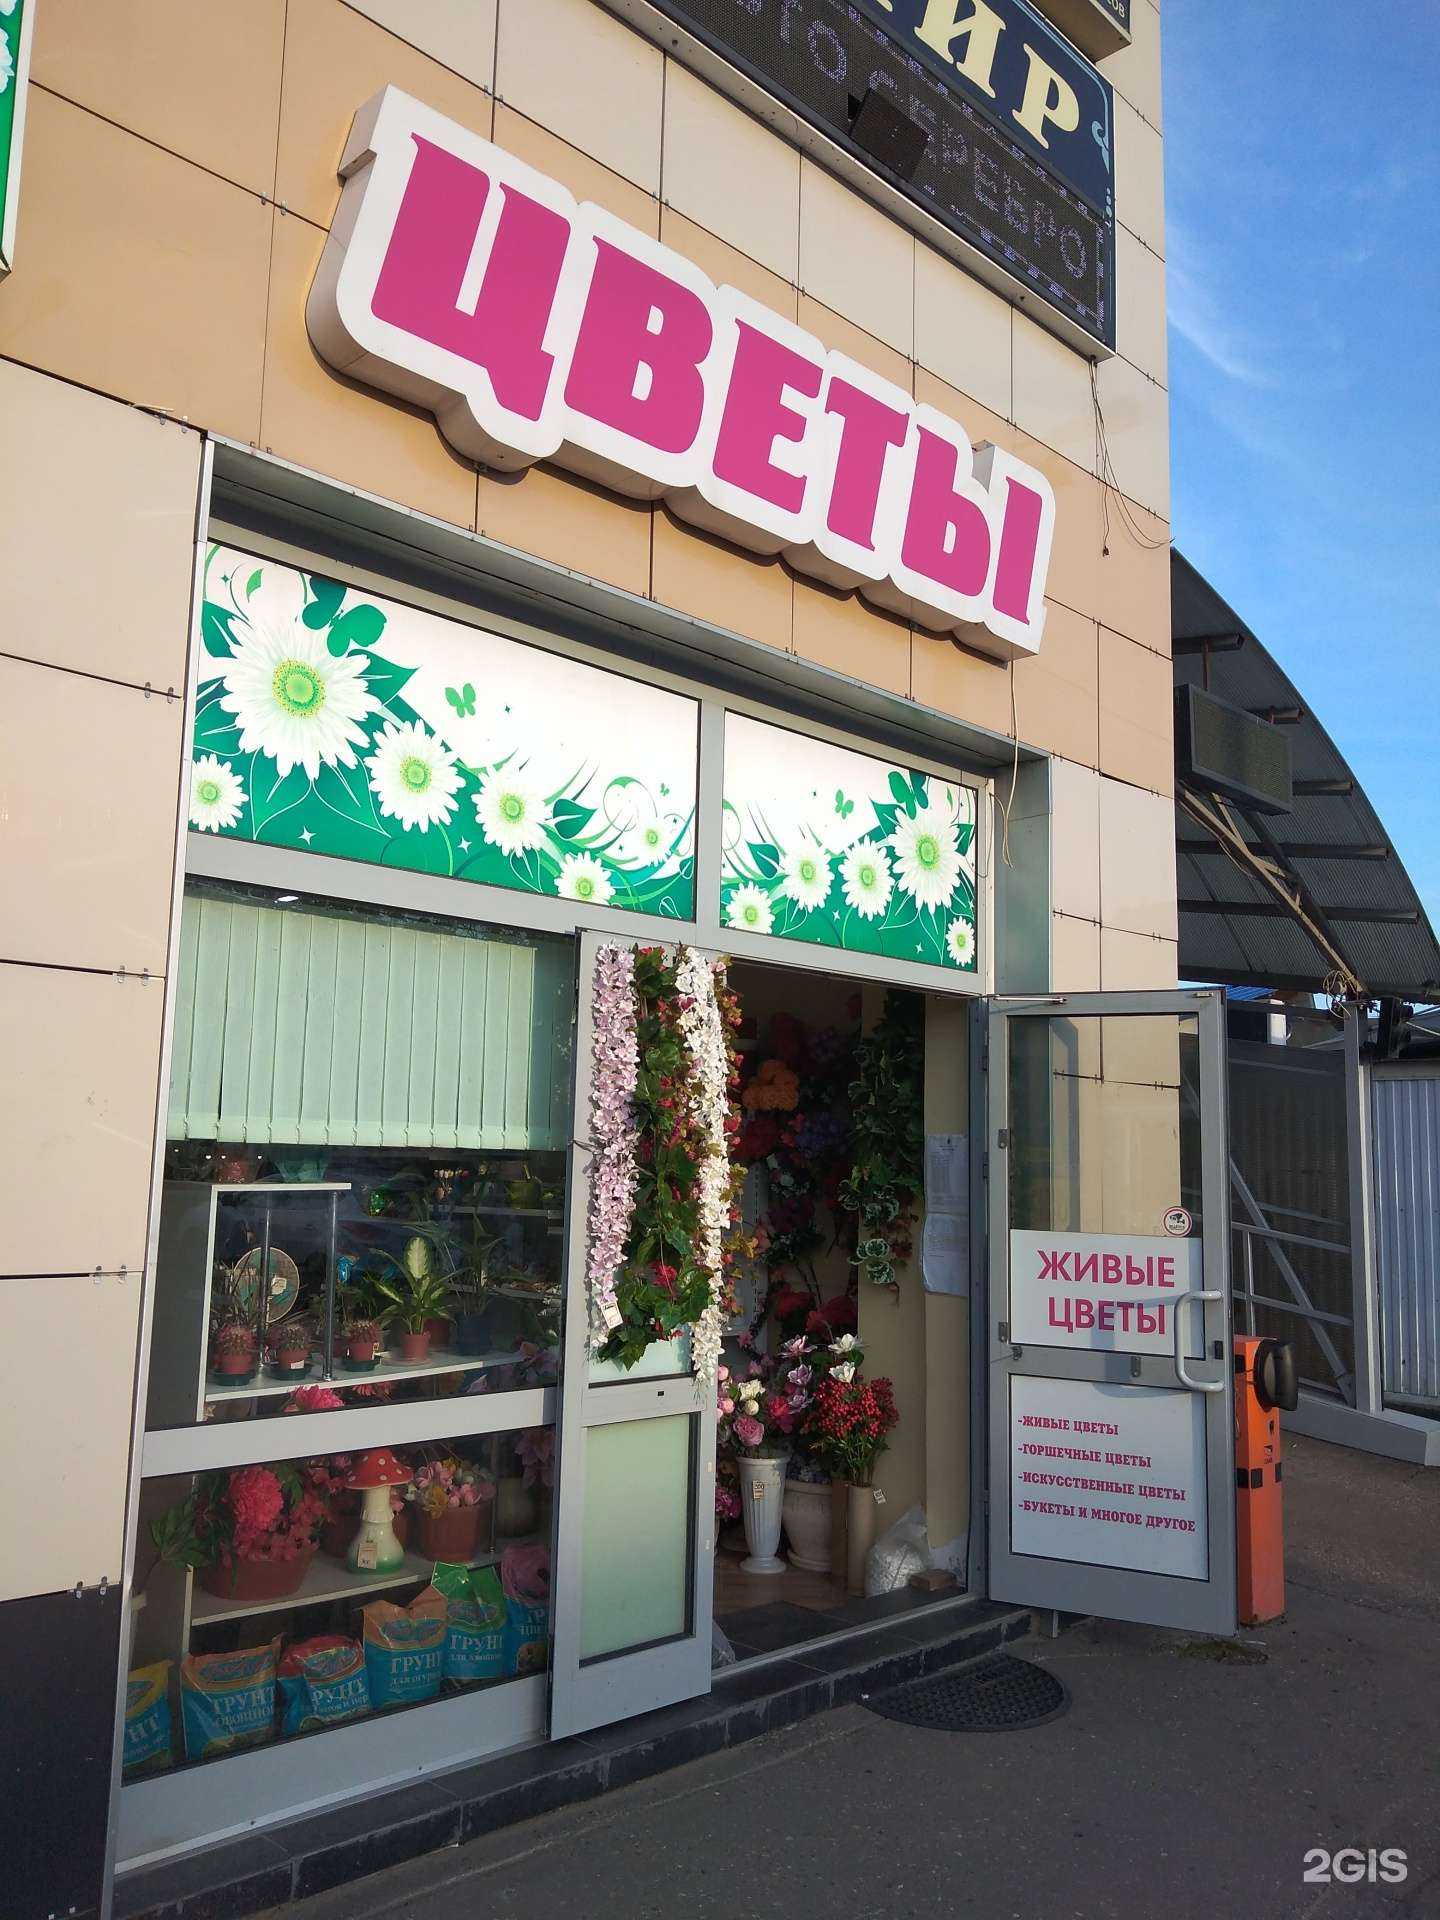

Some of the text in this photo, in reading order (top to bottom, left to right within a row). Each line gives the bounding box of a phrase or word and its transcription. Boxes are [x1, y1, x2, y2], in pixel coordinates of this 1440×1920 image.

[371, 133, 1043, 625] ЦВЕТЫ
[1037, 1249, 1175, 1288] ЖИВЫЕ
[1048, 1296, 1165, 1335] ЦВЕТЫ
[1018, 1415, 1119, 1436] -ЖИВЫЕ ЦВЕТЫ
[1018, 1443, 1152, 1468] -ГОРШЕЧНЫЕ ЦВЕТЫ
[1018, 1471, 1186, 1501] -ИСКУССТВЕННЫЕ ЦВЕТЫ
[1018, 1500, 1196, 1532] -БУКЕТЫ И МНОГОЕ ДРУГОЕ
